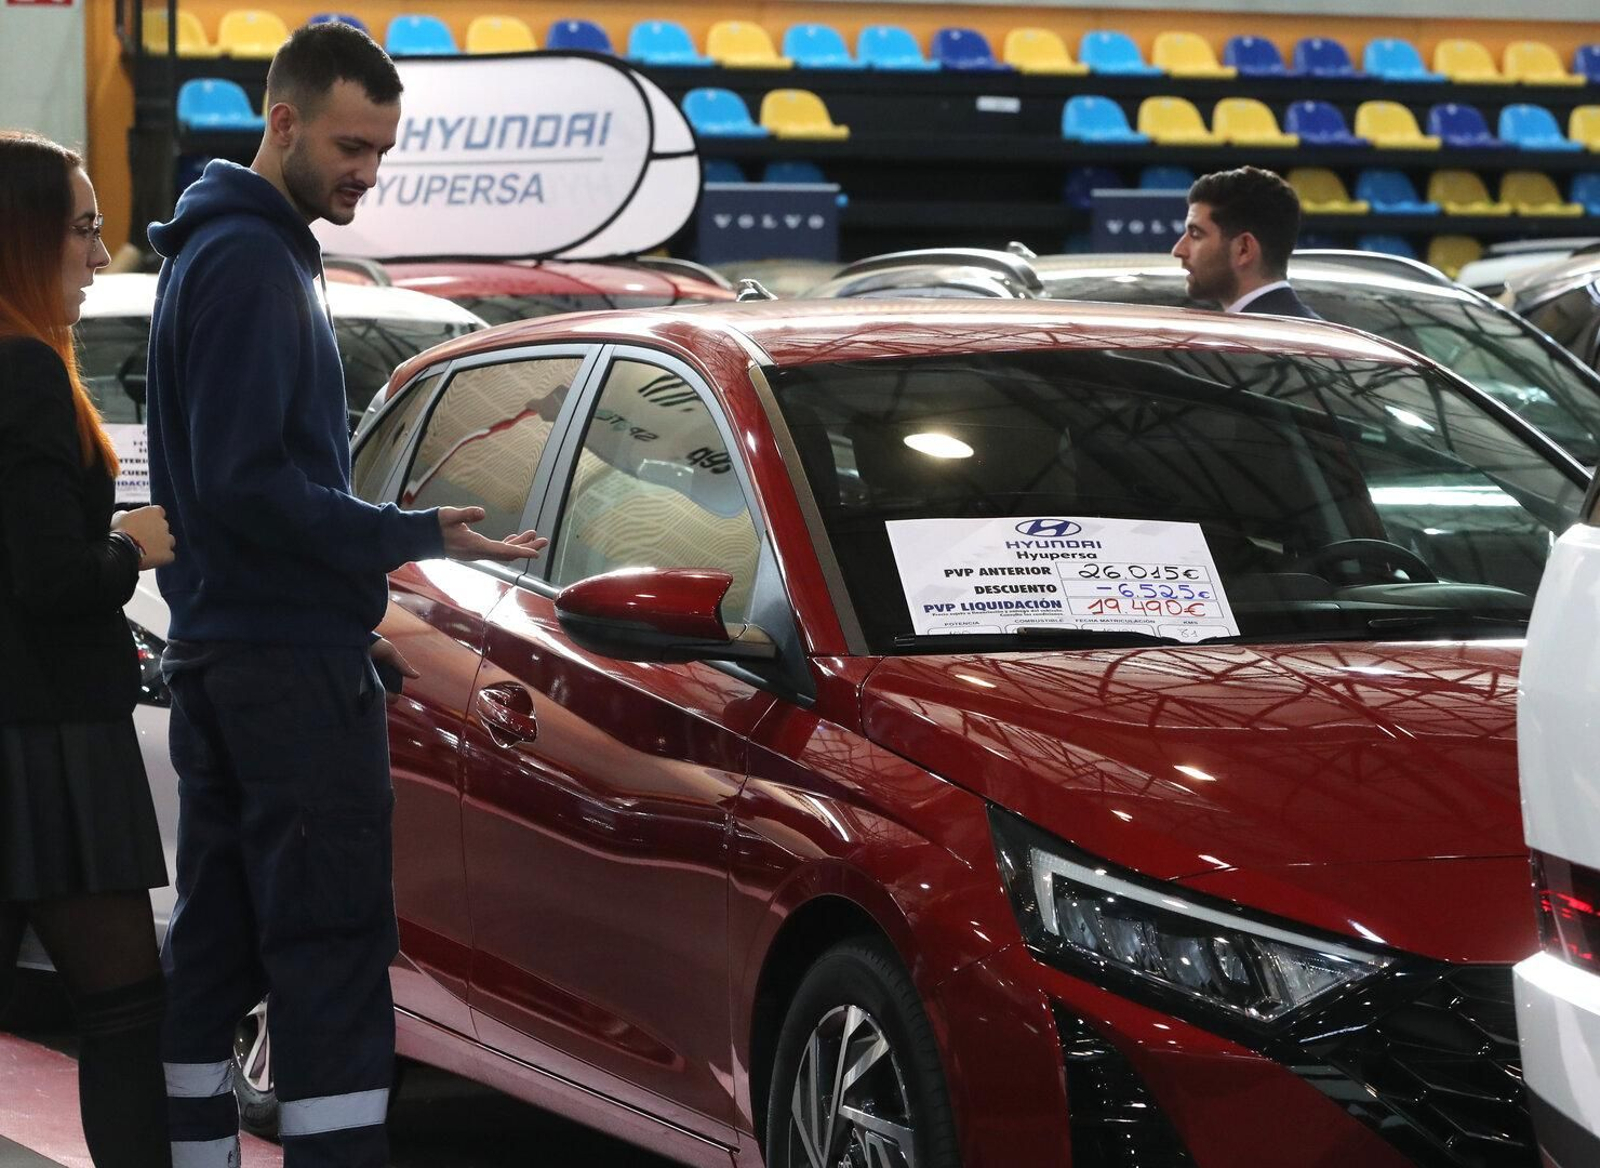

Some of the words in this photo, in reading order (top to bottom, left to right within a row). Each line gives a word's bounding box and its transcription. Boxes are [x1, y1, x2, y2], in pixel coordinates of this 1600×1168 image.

[400, 112, 612, 152] HYUNDAI
[360, 173, 545, 208] YUPERSA
[713, 213, 825, 230] VOLVO
[1105, 219, 1187, 235] VOLV
[1005, 539, 1103, 550] HYUNDAI
[1016, 550, 1098, 562] Hyupersa
[944, 568, 974, 578] PVP
[979, 566, 1052, 577] ANTERIOR
[974, 584, 1057, 595] DESCUENTO
[923, 604, 956, 613] PVP
[960, 598, 1063, 612] LIQUIDACIÓN
